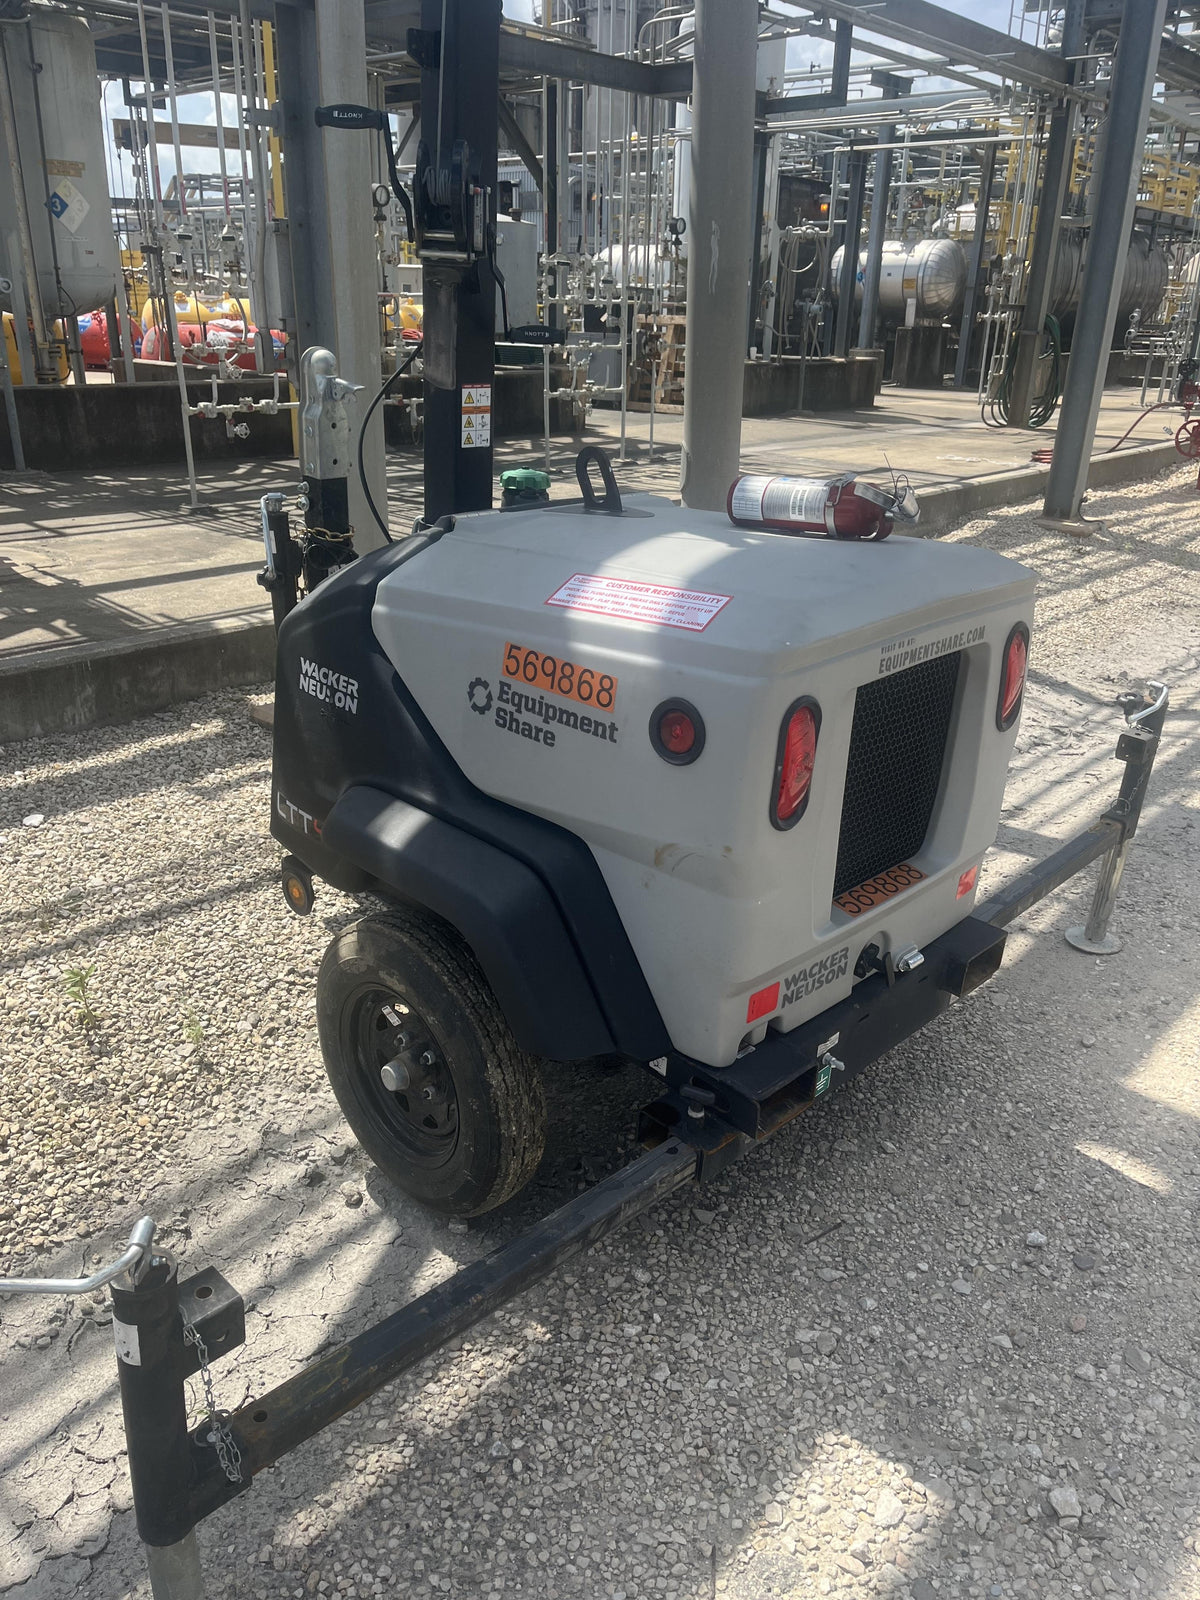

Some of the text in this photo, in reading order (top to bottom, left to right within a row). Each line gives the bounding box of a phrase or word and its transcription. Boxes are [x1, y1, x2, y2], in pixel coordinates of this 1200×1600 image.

[51, 199, 61, 212] 3
[604, 581, 723, 604] CUSTOMER RESPONSIBILITY
[879, 625, 985, 674] EQUIPMENTSHARE.COM
[881, 643, 896, 655] VISIT
[300, 656, 359, 698] WACKER
[505, 643, 614, 708] 569868
[495, 706, 556, 748] Share
[497, 680, 619, 743] Equipment
[832, 863, 924, 914] 569868
[781, 962, 849, 1008] NEUSON
[784, 946, 850, 991] WACKER
